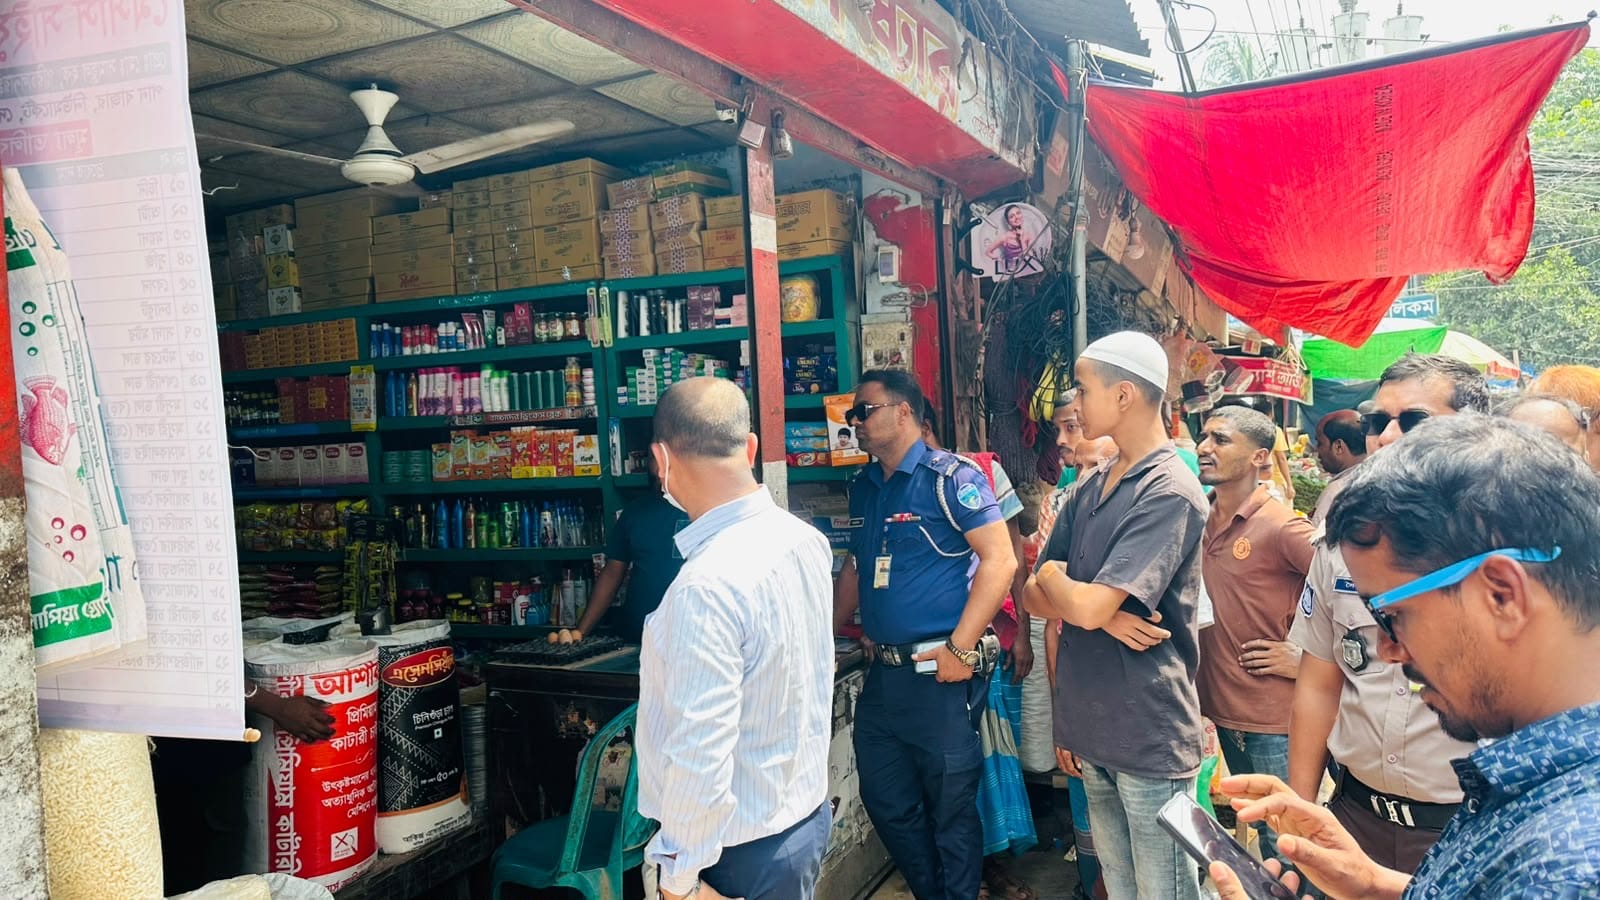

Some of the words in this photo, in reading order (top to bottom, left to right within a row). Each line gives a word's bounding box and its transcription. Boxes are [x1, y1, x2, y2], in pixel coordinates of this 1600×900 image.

[995, 255, 1037, 275] LUX
[32, 603, 80, 630] াপিয়া
[329, 726, 368, 752] কাটারী
